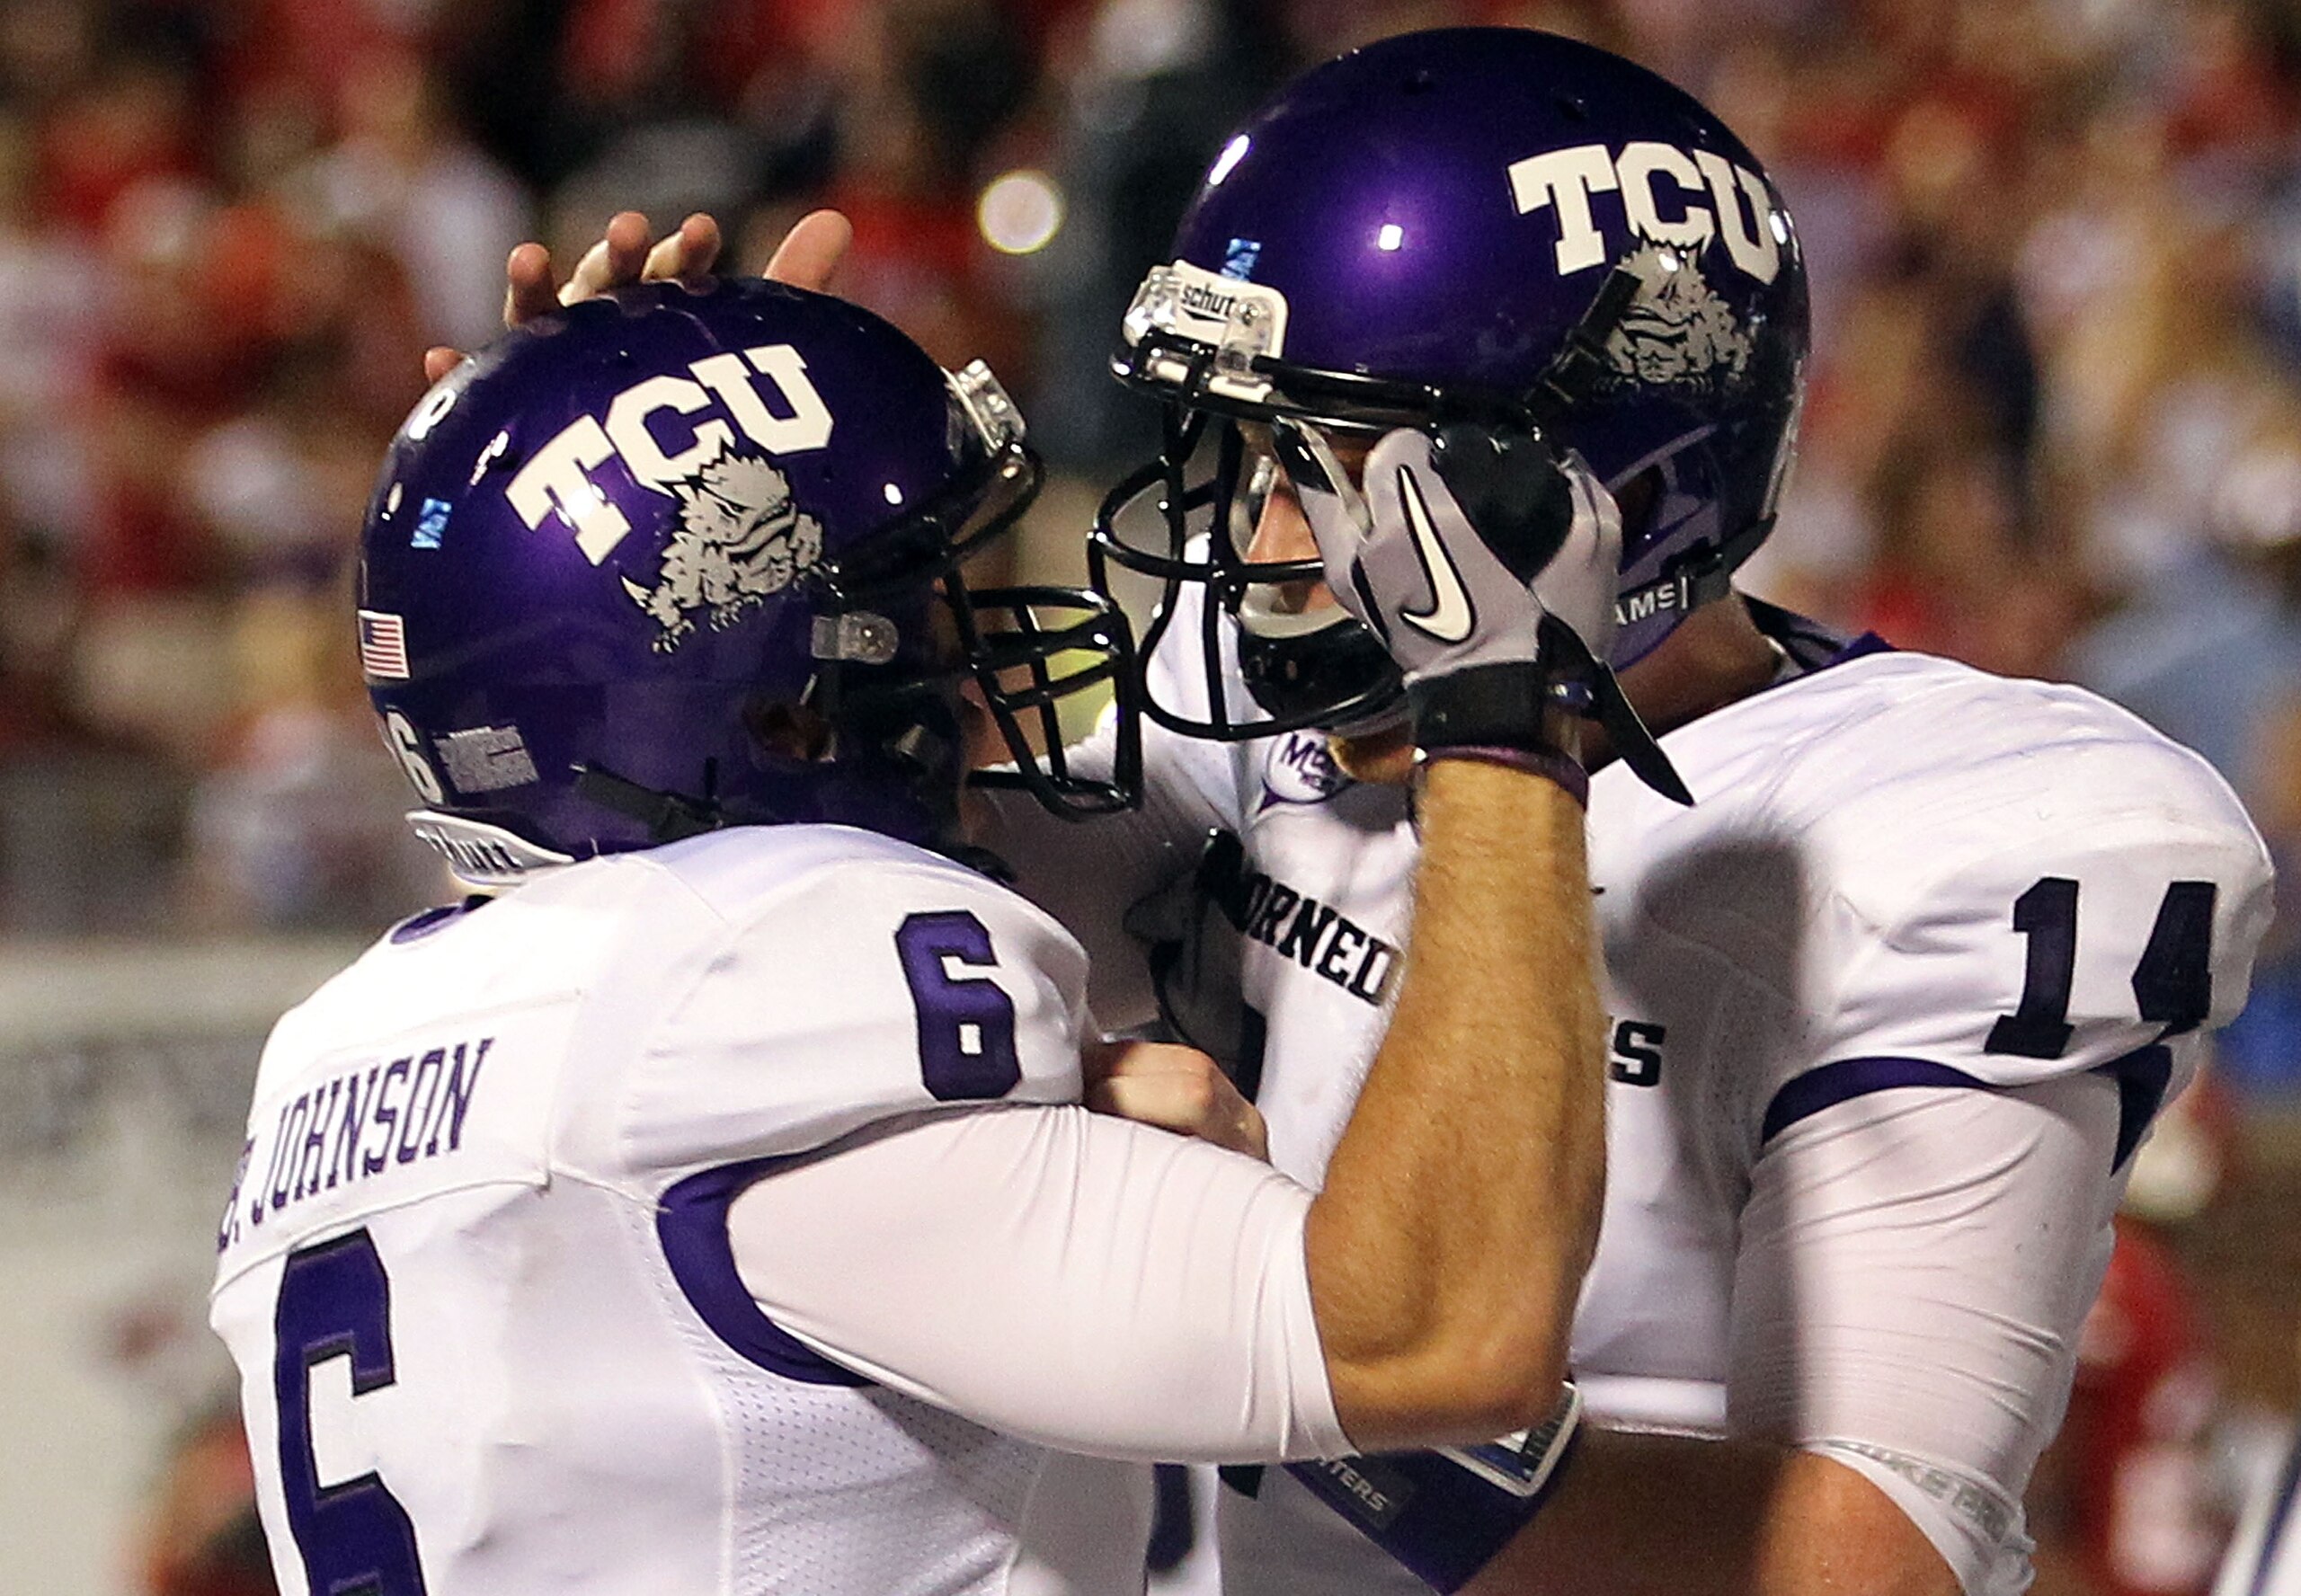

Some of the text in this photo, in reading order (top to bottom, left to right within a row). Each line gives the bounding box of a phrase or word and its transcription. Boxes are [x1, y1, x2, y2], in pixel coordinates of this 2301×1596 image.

[1507, 141, 1780, 286] TCU
[1180, 283, 1238, 317] schut
[504, 343, 835, 566] TCU
[386, 711, 444, 805] 6
[893, 909, 1023, 1102] 6
[1246, 872, 1404, 1006] ORNED
[1984, 876, 2217, 1060] 14
[251, 1036, 495, 1227] JOHNSON
[1327, 1460, 1390, 1512] TERS
